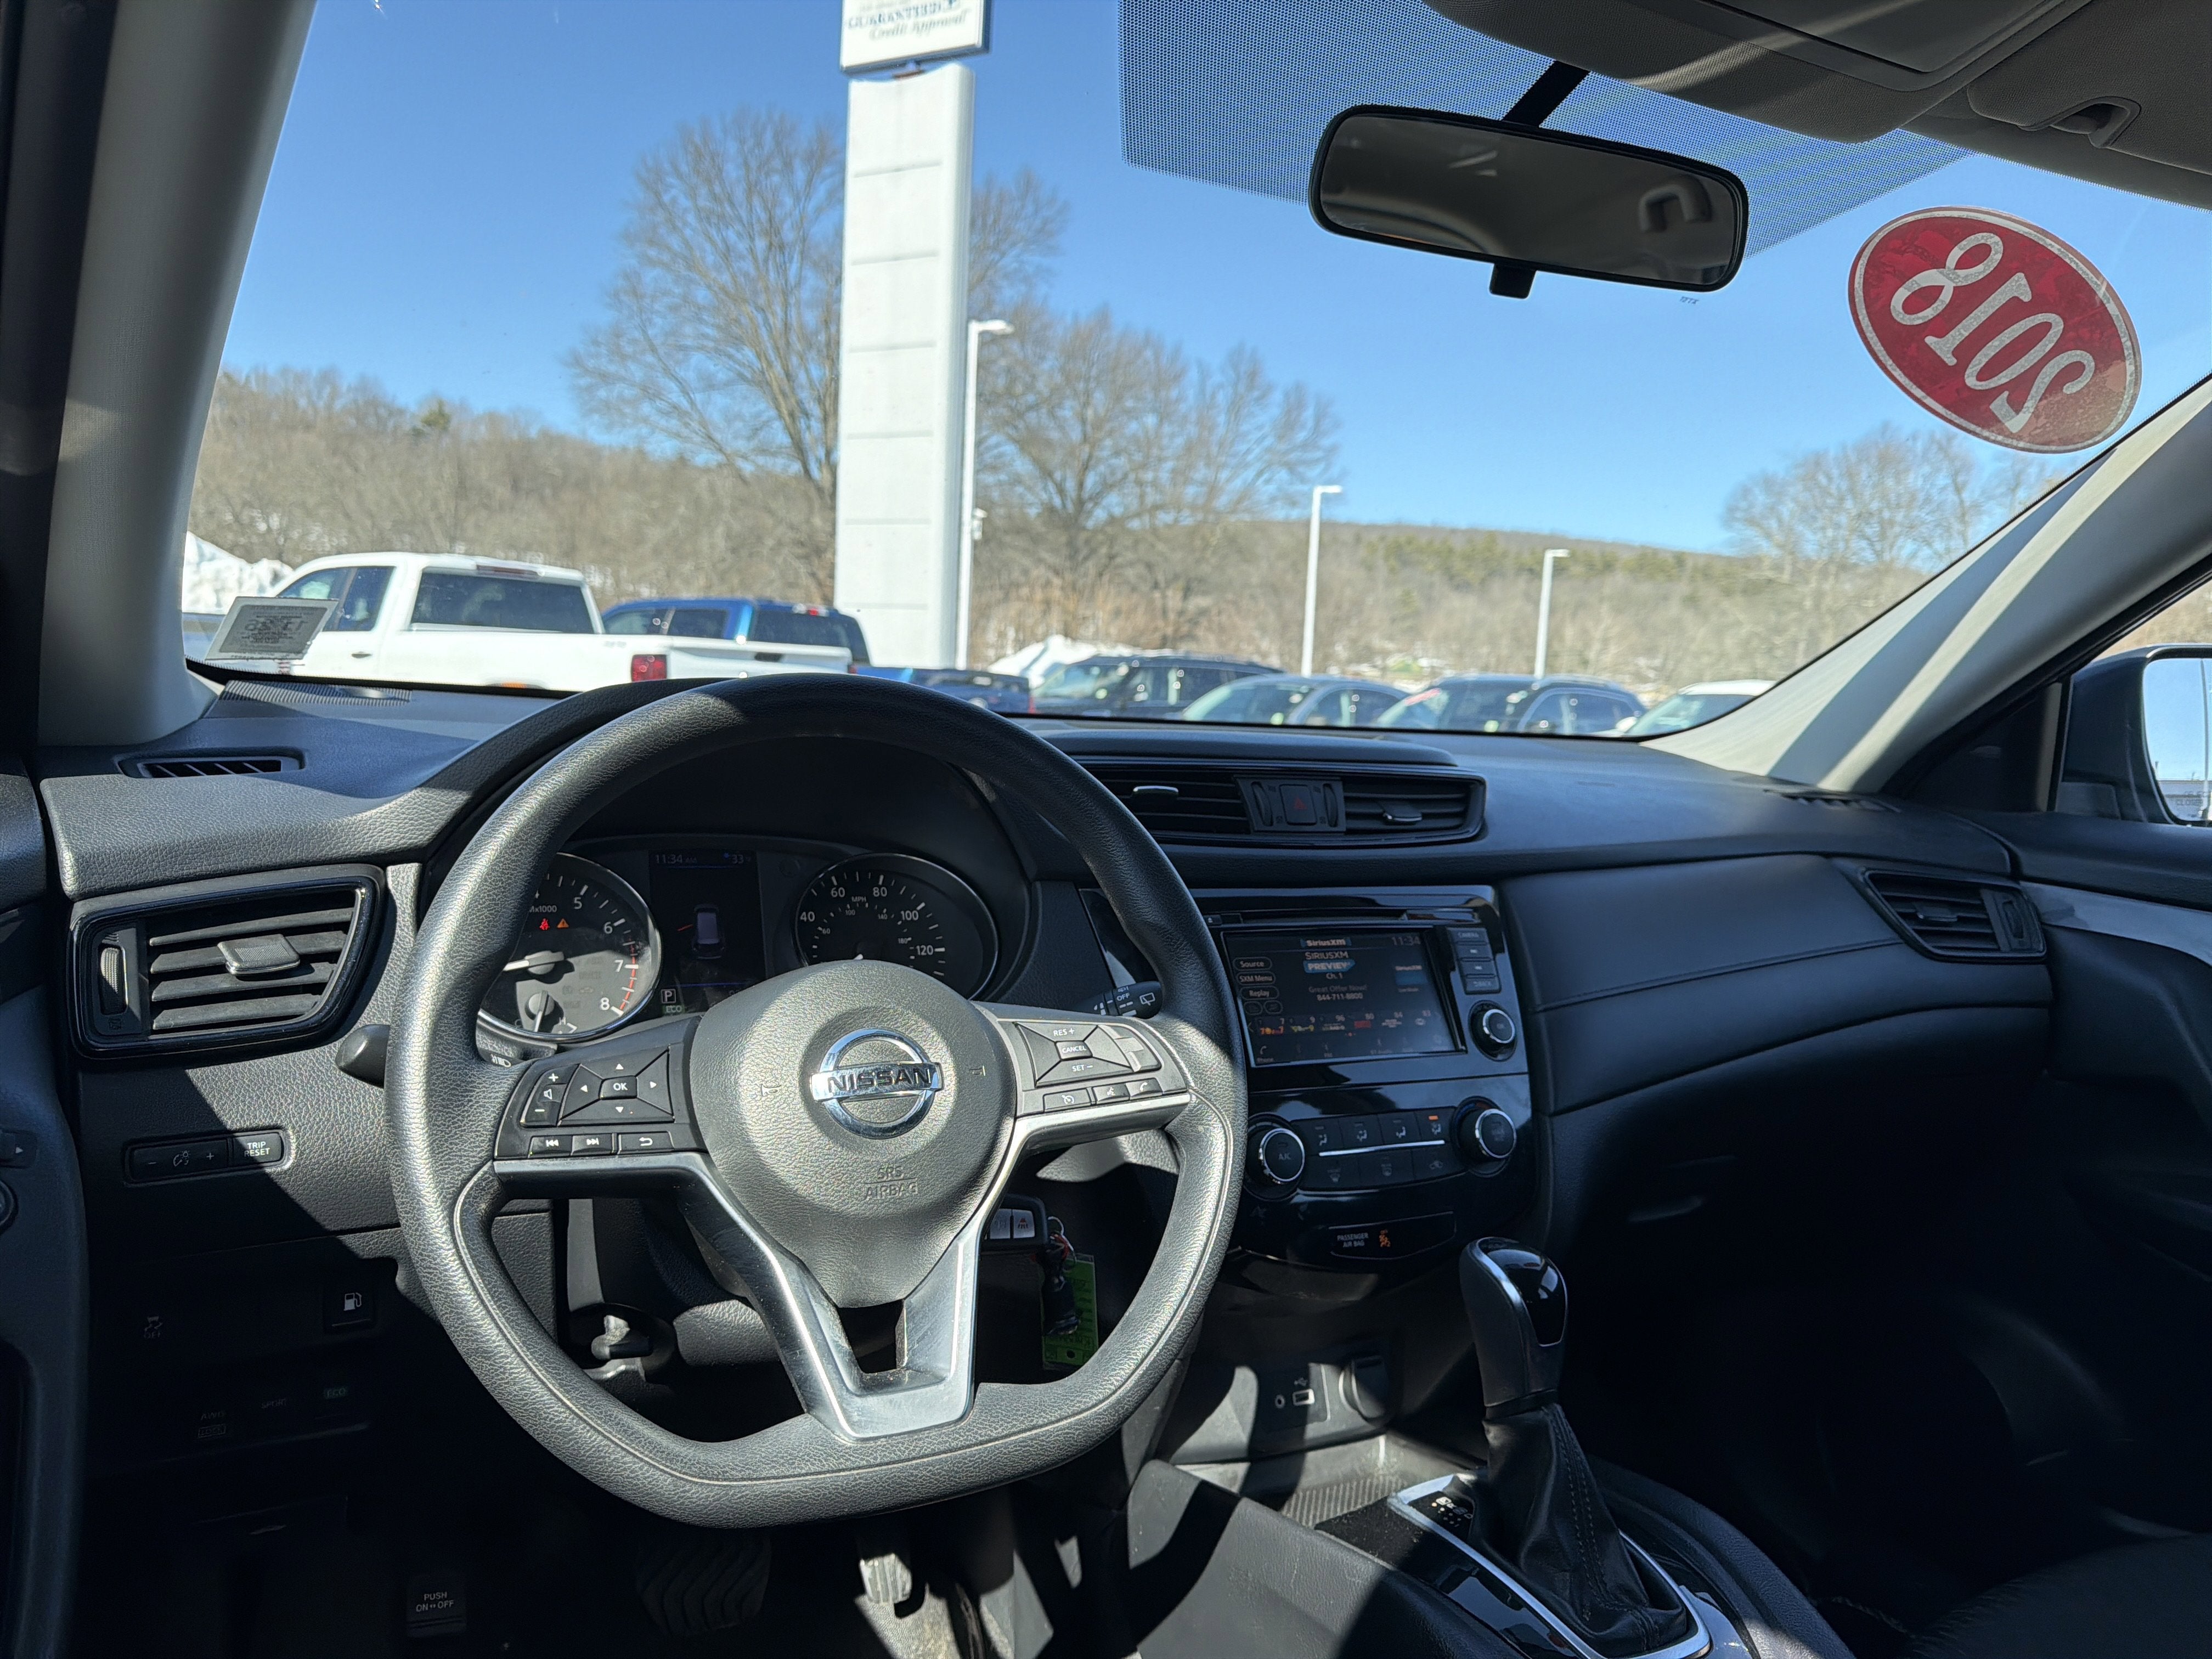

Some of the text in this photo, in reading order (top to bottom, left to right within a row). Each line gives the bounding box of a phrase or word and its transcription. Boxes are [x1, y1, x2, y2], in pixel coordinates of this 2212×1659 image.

[656, 854, 682, 864] 11:34
[831, 888, 845, 898] 60
[873, 888, 887, 897] 80
[573, 898, 583, 910] 5
[800, 912, 815, 922] 40
[901, 911, 919, 921] 100
[604, 923, 613, 934] 6
[1391, 935, 1421, 946] 11:34
[916, 945, 934, 955] 120
[1305, 951, 1349, 960] SIRIUSXM
[616, 960, 624, 972] 7
[1240, 960, 1265, 968] Source
[665, 991, 673, 1001] P
[1116, 992, 1130, 1001] OFF
[1249, 989, 1270, 998] Replay
[600, 998, 611, 1011] 8
[1062, 1045, 1087, 1053] CANCEL
[827, 1067, 932, 1094] NISSAN
[613, 1082, 628, 1091] OK
[244, 1147, 270, 1157] RESET
[878, 1165, 903, 1179] SRS
[865, 1182, 919, 1200] AIRBAG
[424, 1591, 448, 1601] PUSH
